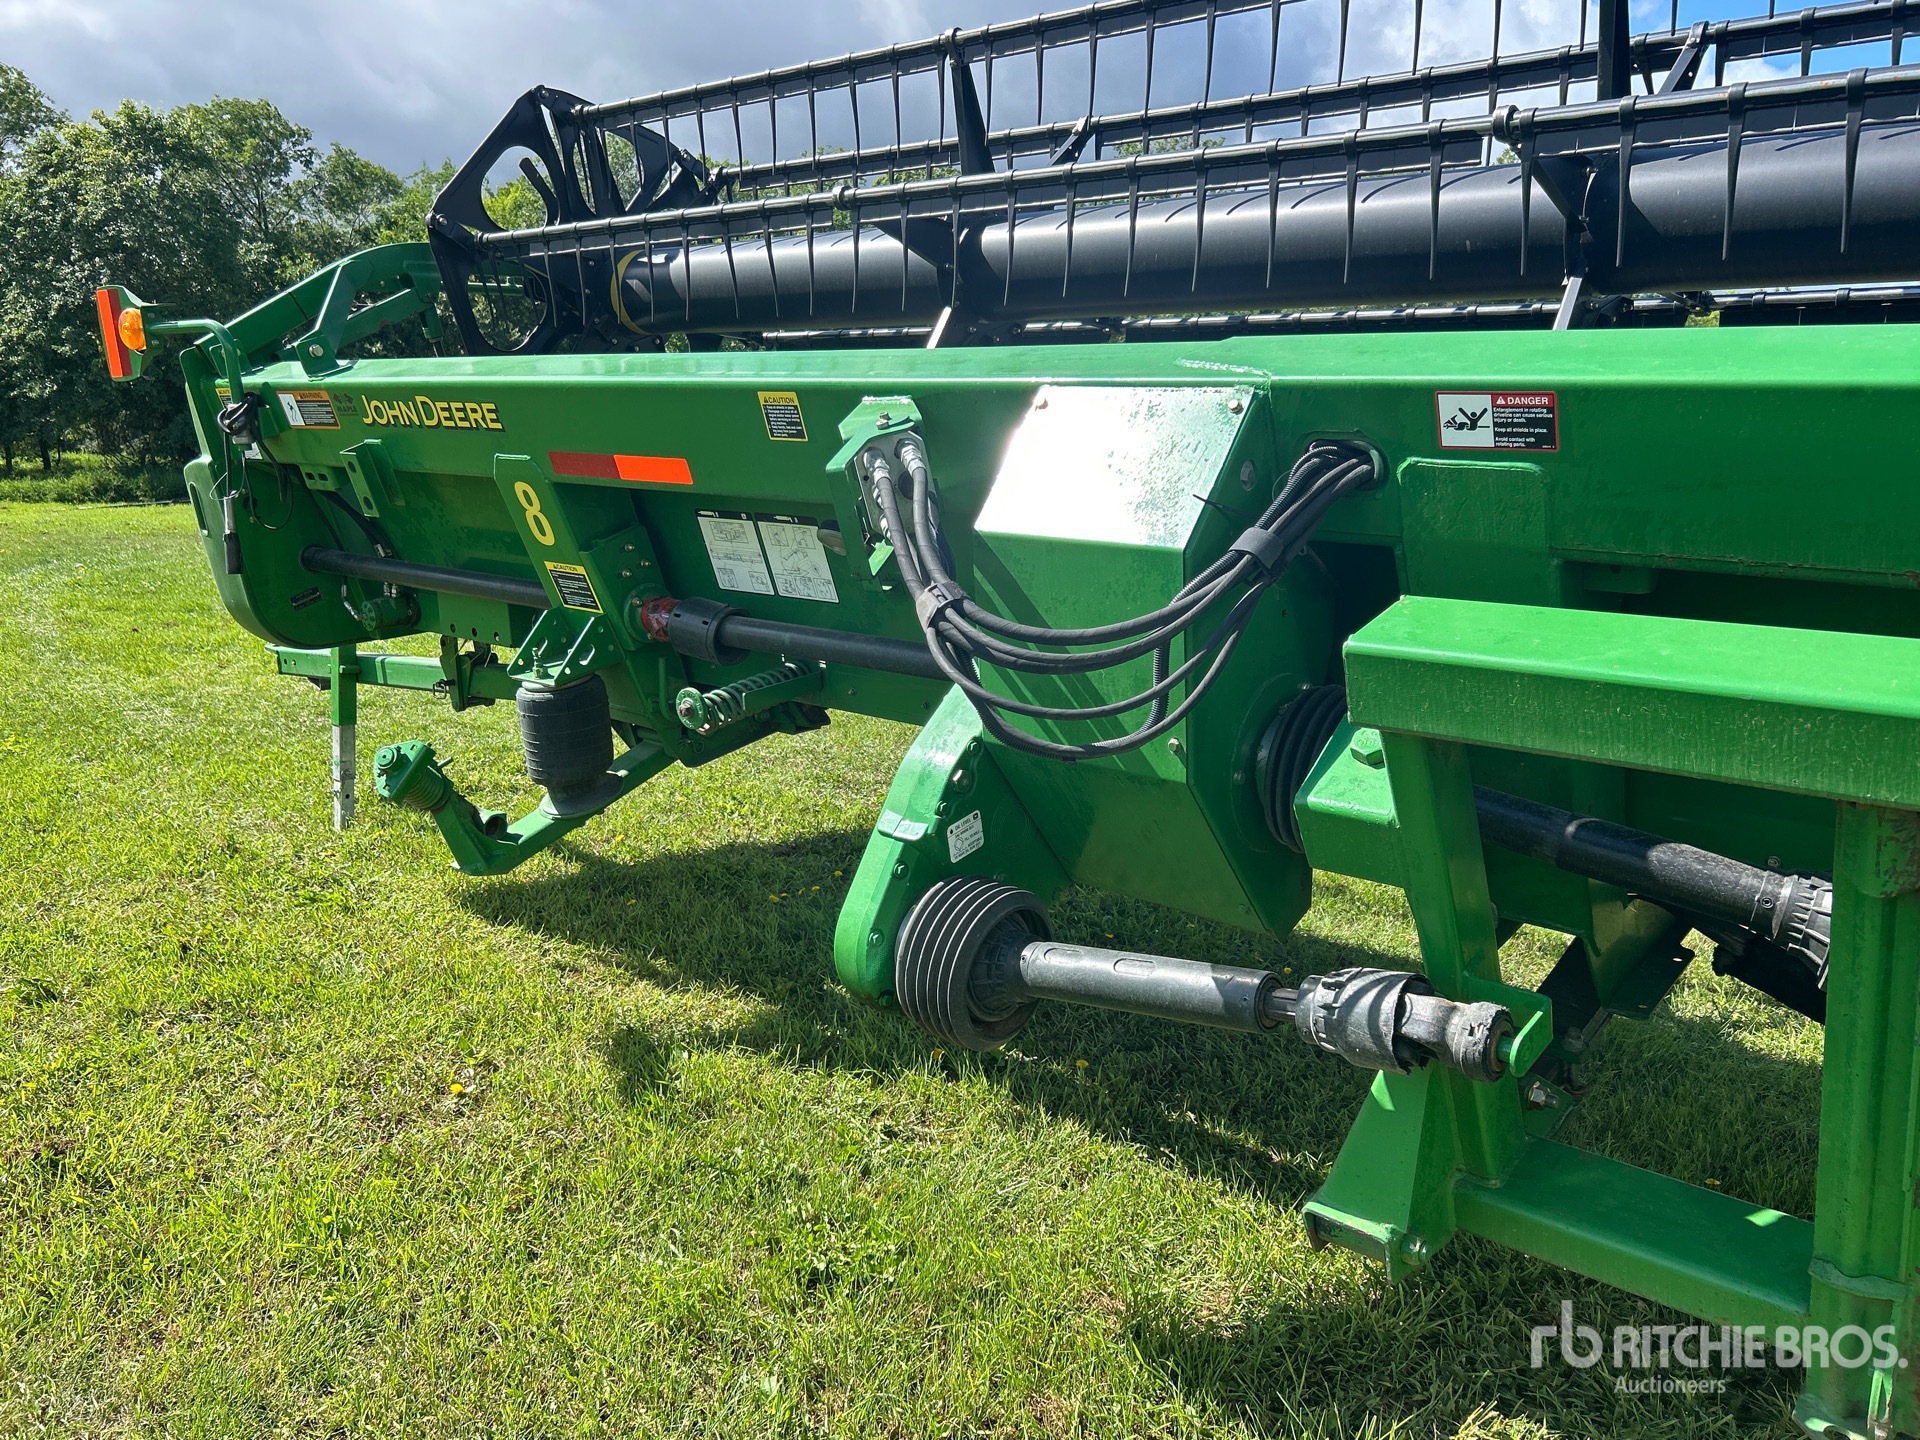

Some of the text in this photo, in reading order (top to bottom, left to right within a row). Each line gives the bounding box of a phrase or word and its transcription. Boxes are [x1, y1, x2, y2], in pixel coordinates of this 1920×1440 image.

[362, 394, 421, 427] JOHN
[414, 395, 504, 430] DEERE
[1507, 397, 1548, 405] DANGER
[514, 481, 556, 546] 8
